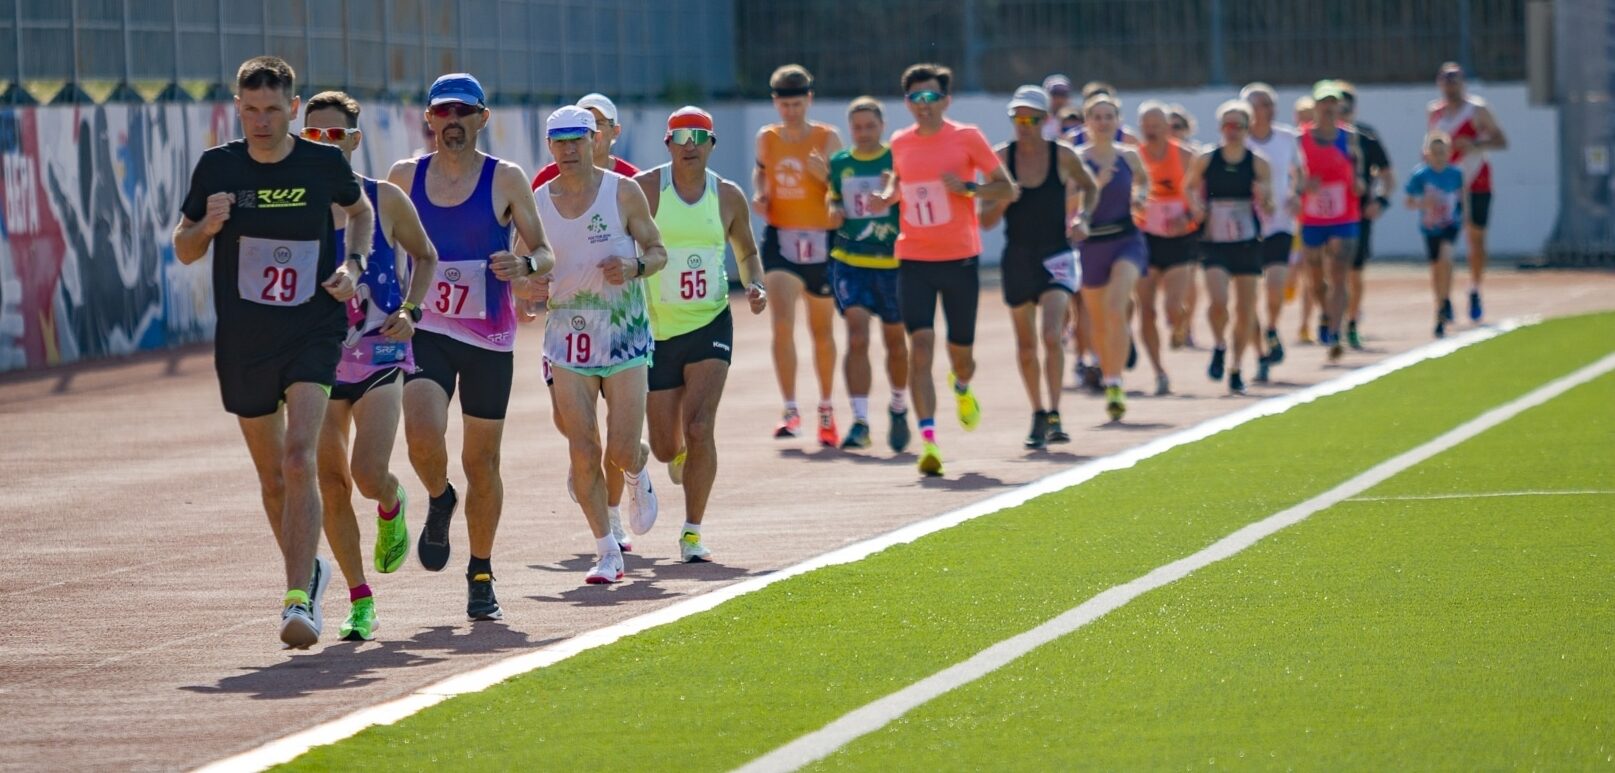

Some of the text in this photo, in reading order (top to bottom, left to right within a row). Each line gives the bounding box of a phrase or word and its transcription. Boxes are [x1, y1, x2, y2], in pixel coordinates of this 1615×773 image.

[915, 201, 934, 225] 11
[261, 266, 297, 302] 29
[435, 281, 469, 314] 37
[680, 270, 706, 300] 55
[375, 345, 396, 353] SRF
[565, 333, 590, 363] 19
